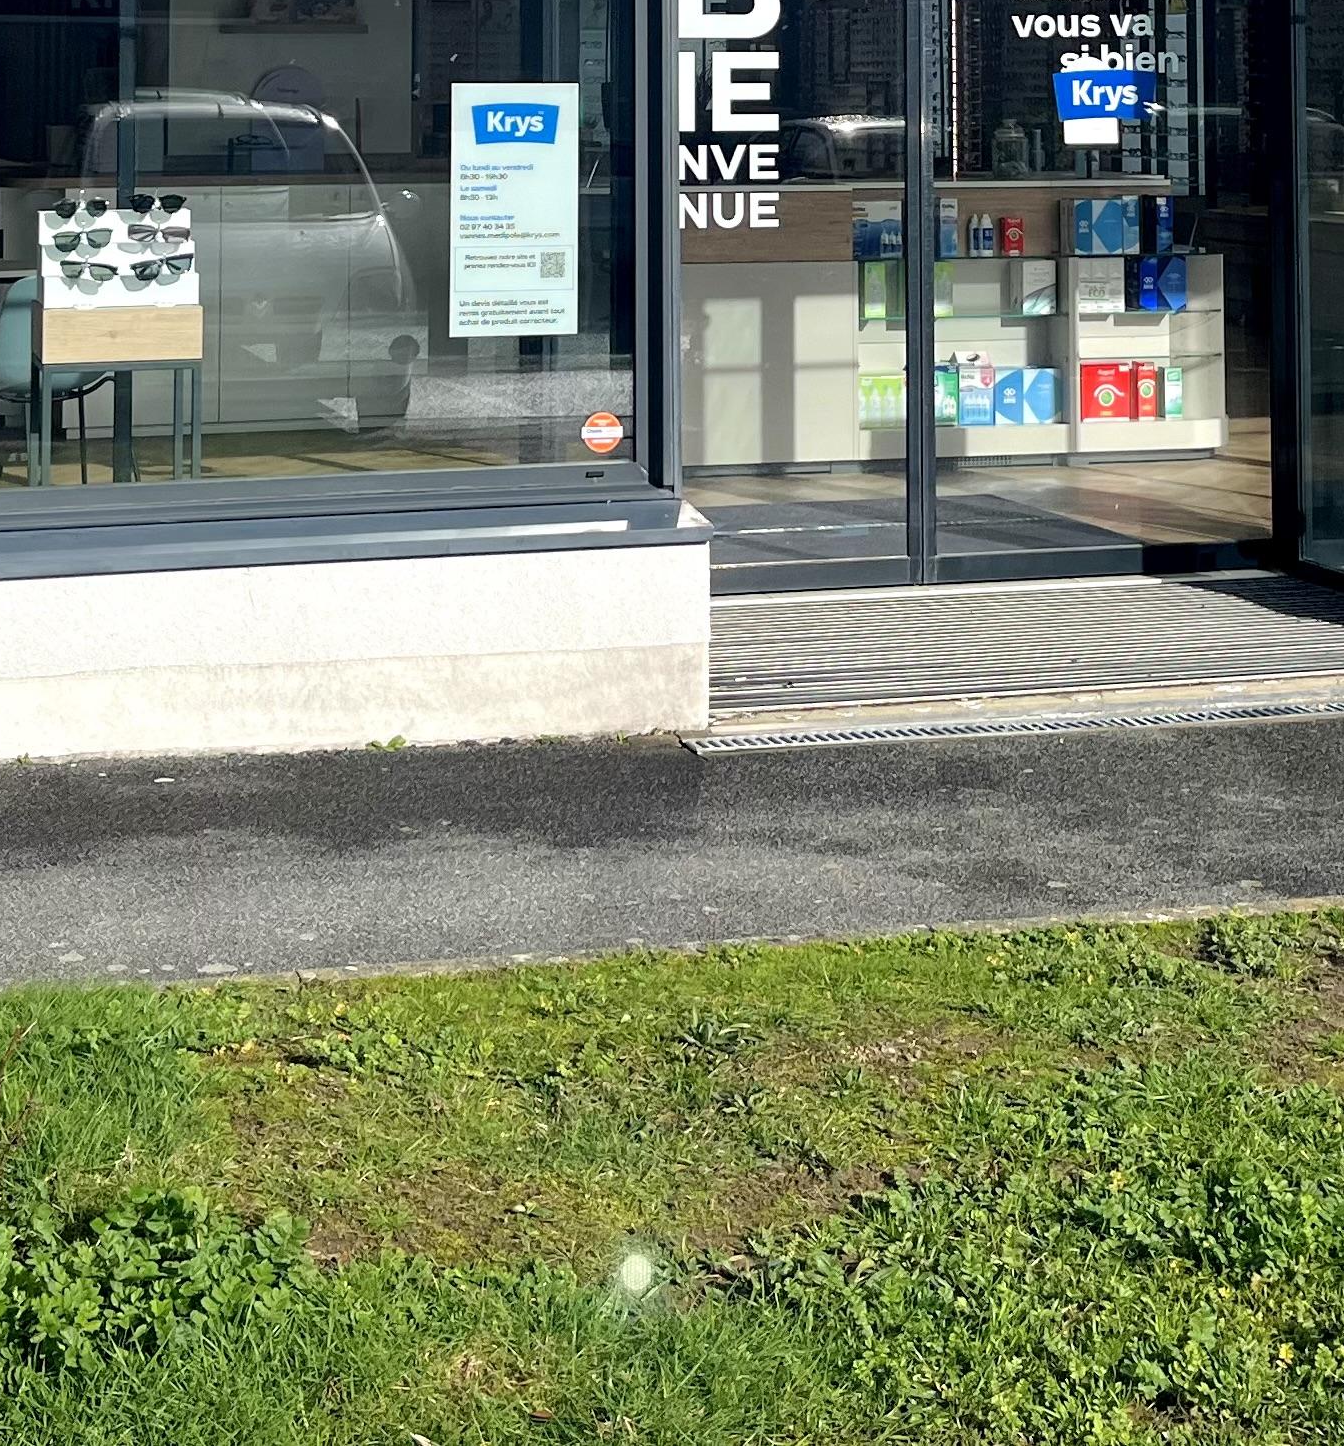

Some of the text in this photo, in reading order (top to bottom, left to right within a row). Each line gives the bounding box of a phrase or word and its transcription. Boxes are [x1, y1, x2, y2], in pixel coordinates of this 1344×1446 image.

[1011, 13, 1155, 38] vous va
[1100, 43, 1180, 74] bien
[679, 52, 780, 132] IE
[1072, 79, 1139, 112] Krys
[486, 110, 545, 138] Krys
[679, 144, 780, 181] NVE
[679, 191, 780, 229] NUE
